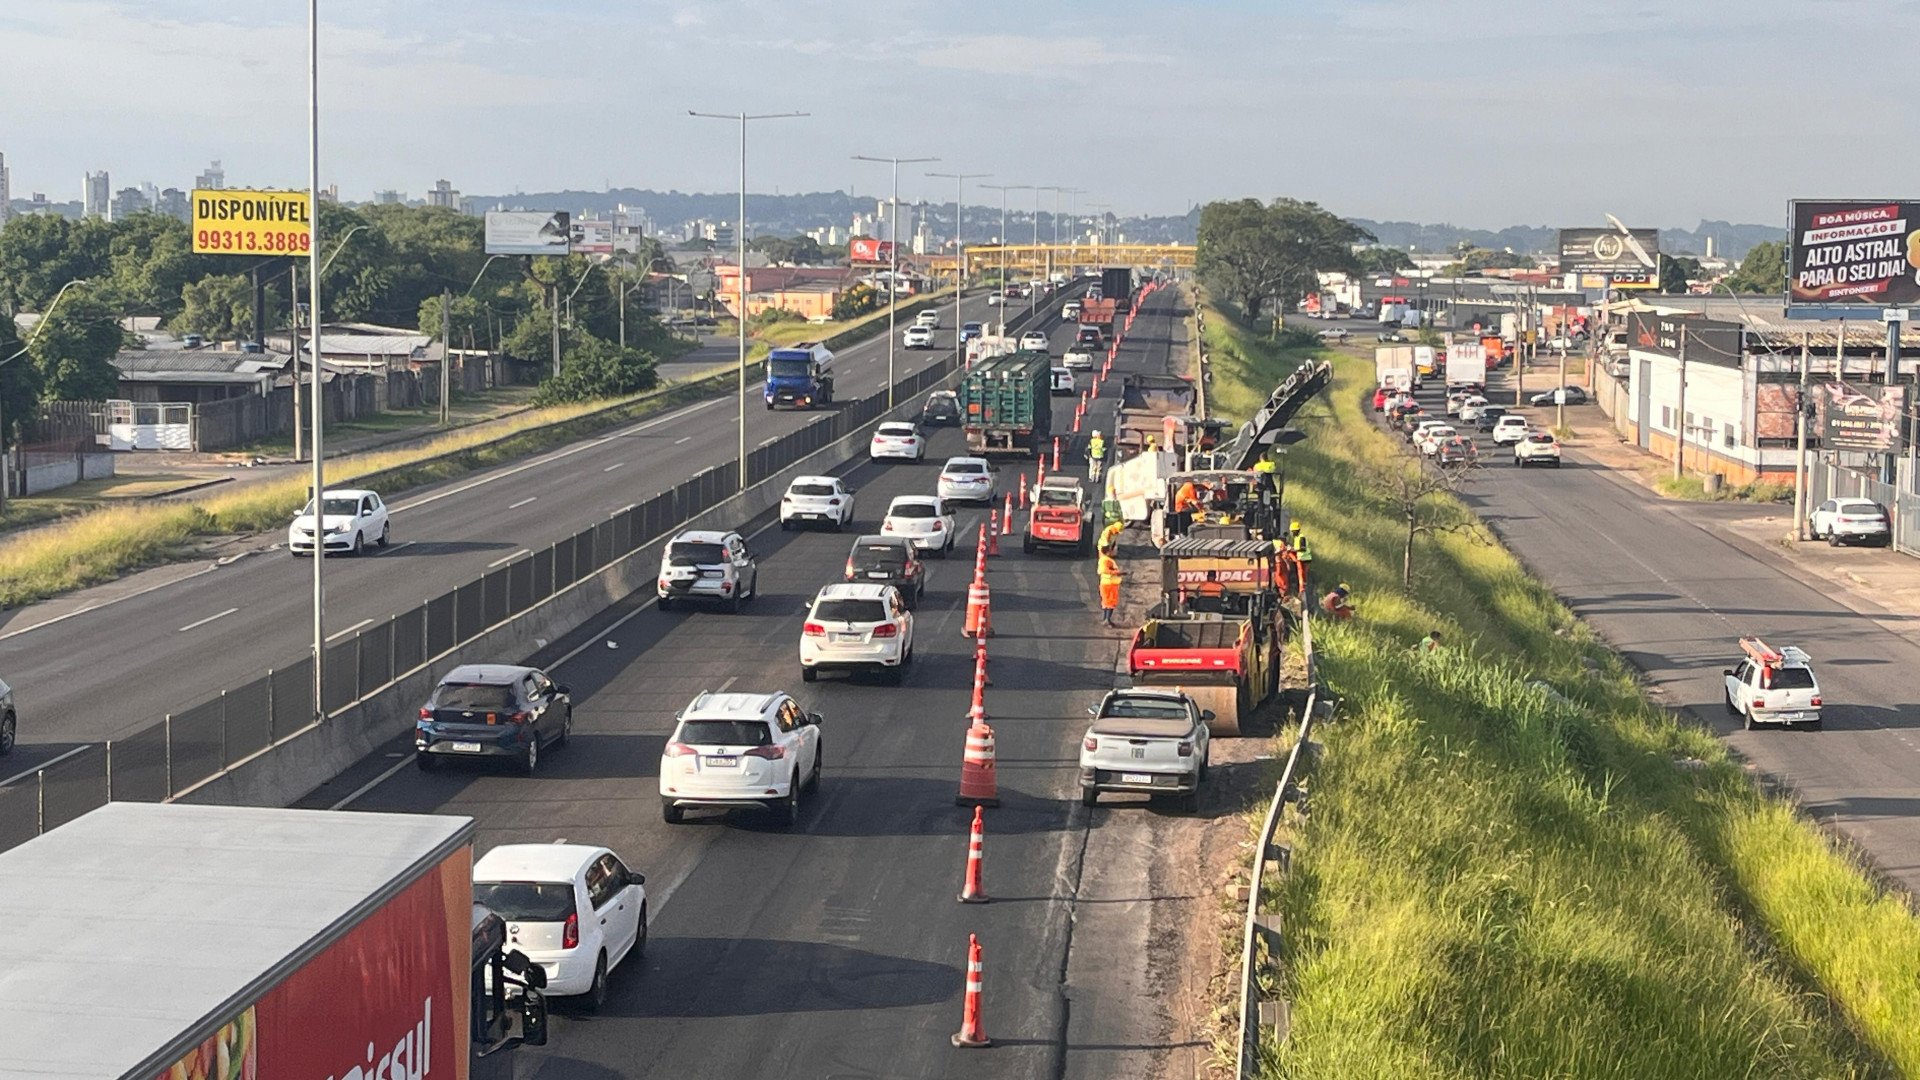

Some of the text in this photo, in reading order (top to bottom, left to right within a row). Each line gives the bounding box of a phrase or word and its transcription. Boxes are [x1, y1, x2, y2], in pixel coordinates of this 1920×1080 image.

[198, 196, 310, 222] DISPONÍVEL
[1819, 210, 1890, 225] BOA MÚSICA,
[198, 230, 310, 252] 99313.3889
[1811, 223, 1898, 241] INFORMAÇÃO E
[1805, 238, 1902, 267] ALTO ASTRAL
[1799, 258, 1906, 288] PARA O SEU DIA!
[1828, 284, 1879, 297] SINTONIZE!
